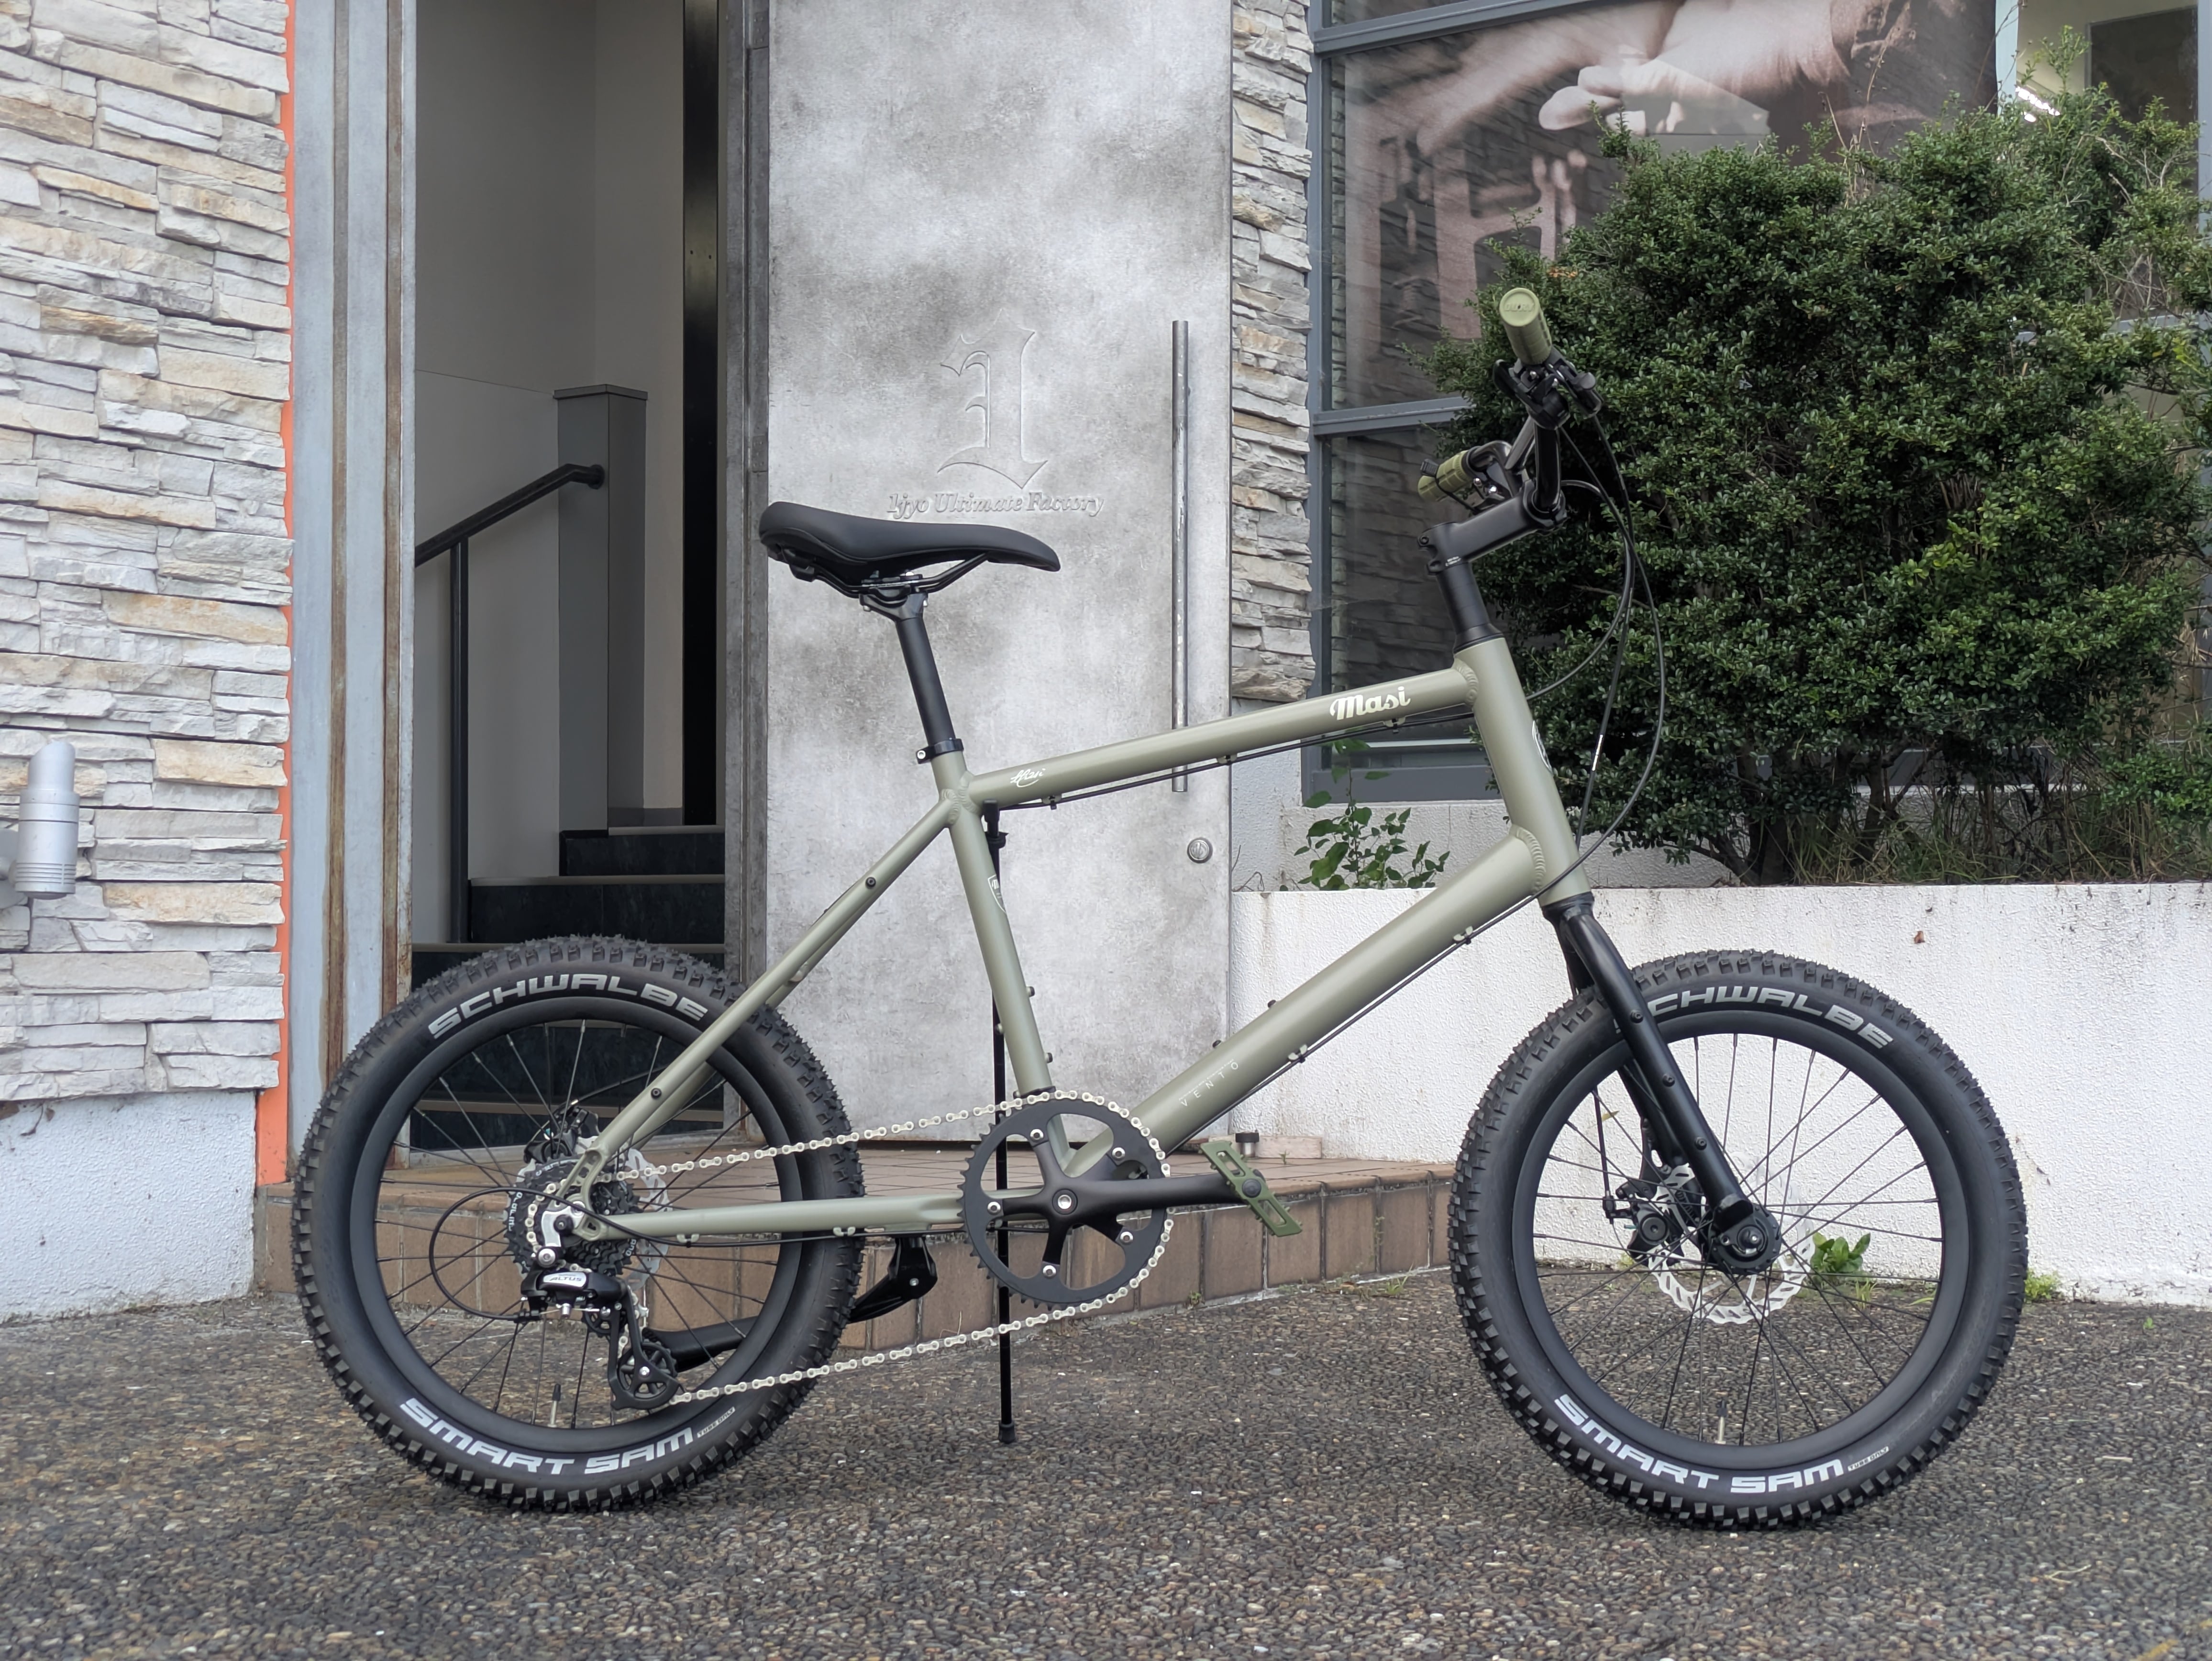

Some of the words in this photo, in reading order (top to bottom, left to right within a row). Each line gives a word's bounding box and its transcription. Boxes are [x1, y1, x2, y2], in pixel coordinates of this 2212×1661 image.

[934, 493, 1023, 513] Ultimate
[1027, 492, 1104, 517] Factory
[1329, 686, 1411, 720] Masi
[429, 974, 708, 1039] SCHWALBE
[1614, 986, 1894, 1049] CHWALBE
[1181, 1062, 1239, 1107] VENTO
[400, 1398, 574, 1475] SMART
[585, 1427, 693, 1474] SAM
[1555, 1394, 1719, 1489] SMART
[1730, 1459, 1844, 1493] SAM
